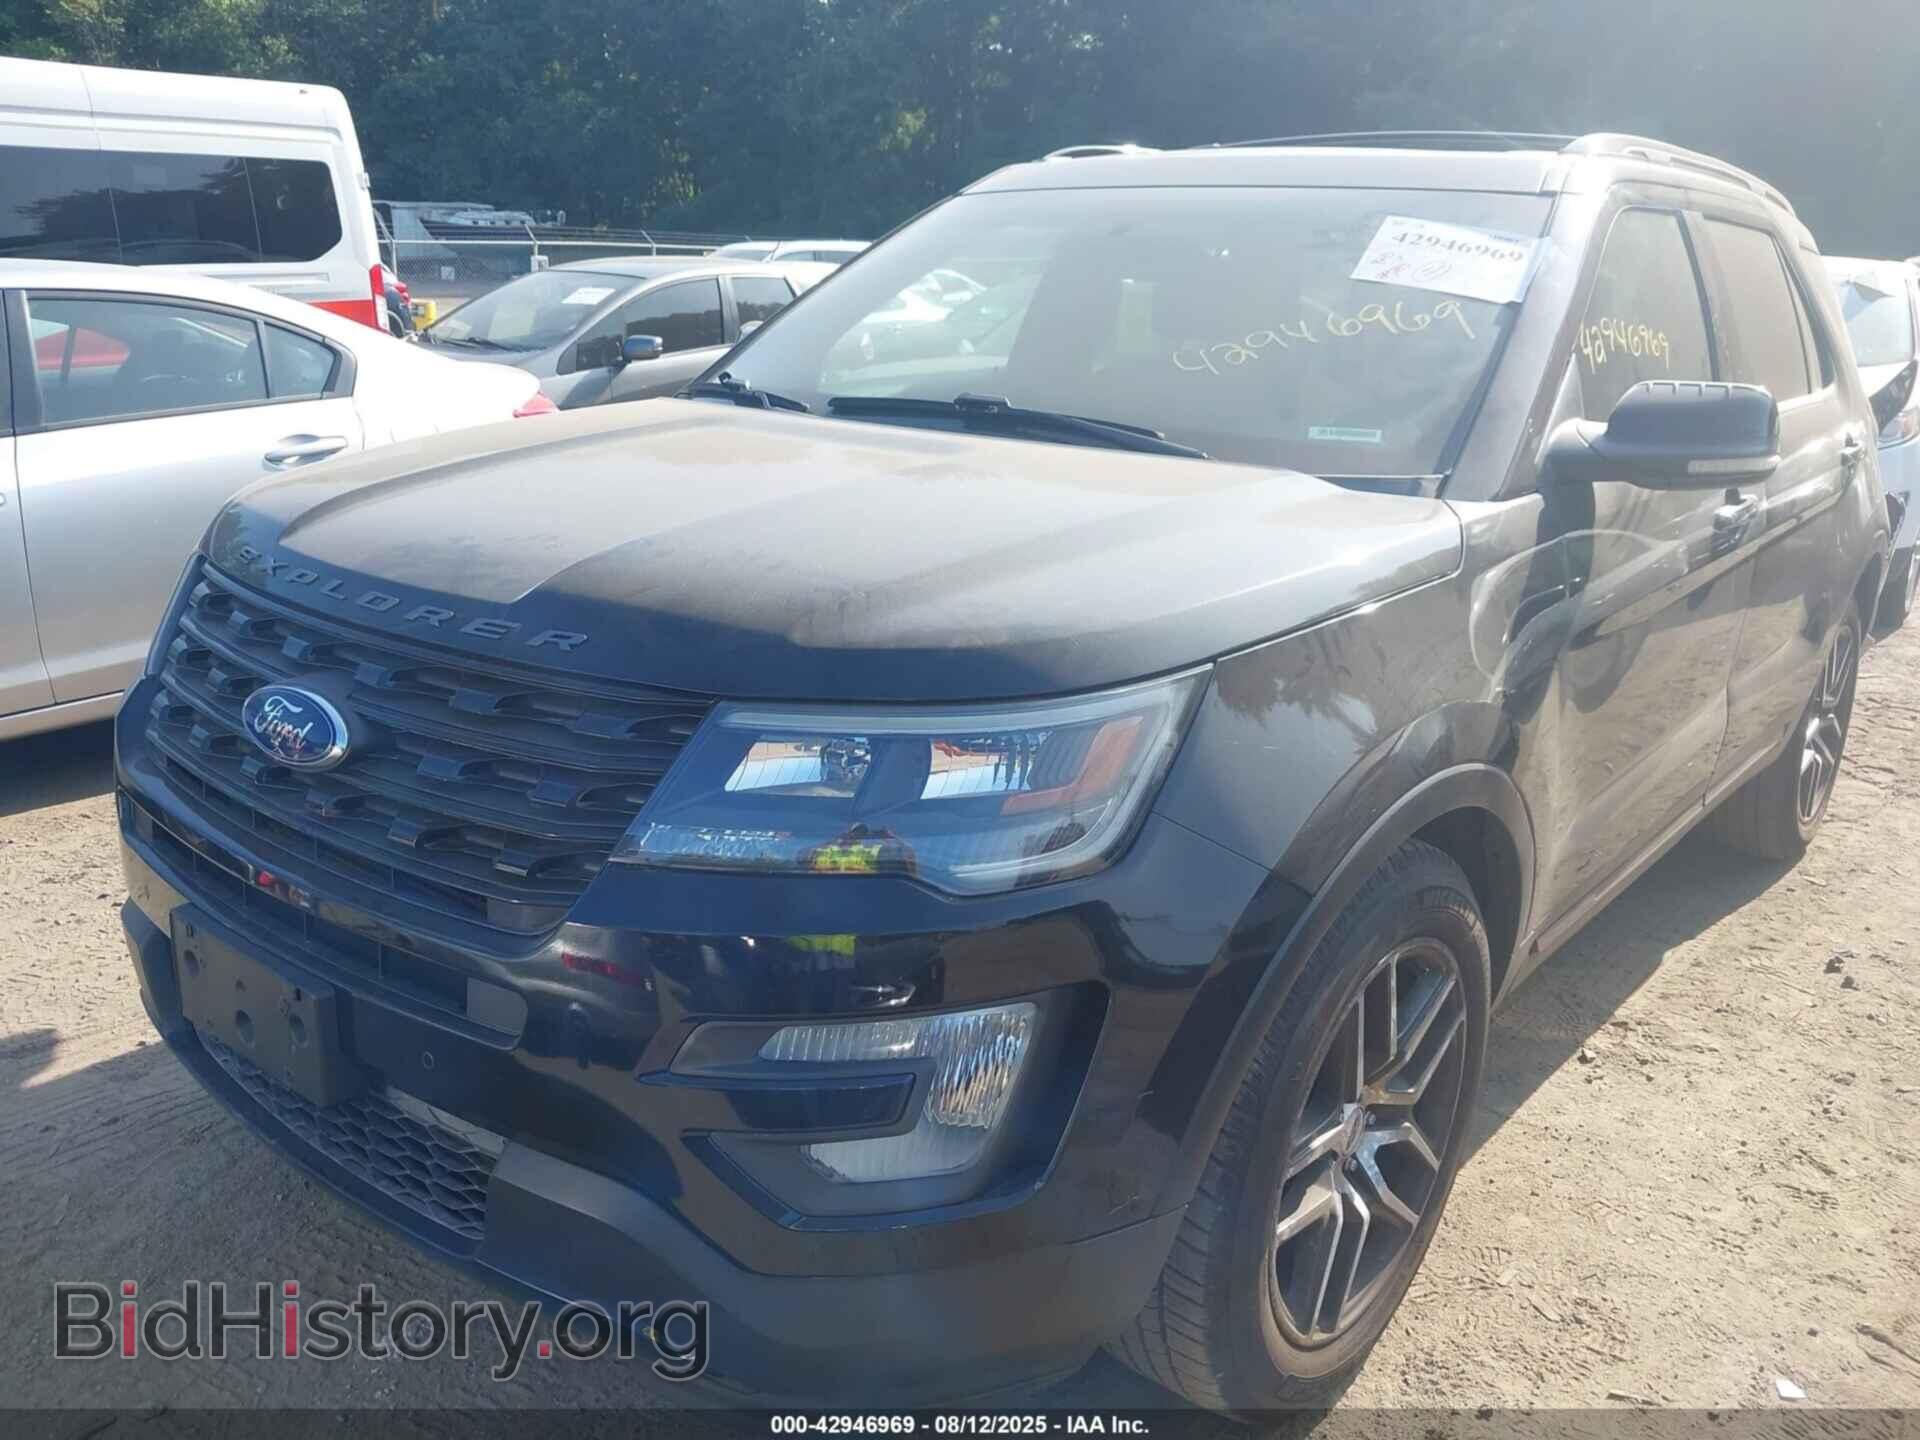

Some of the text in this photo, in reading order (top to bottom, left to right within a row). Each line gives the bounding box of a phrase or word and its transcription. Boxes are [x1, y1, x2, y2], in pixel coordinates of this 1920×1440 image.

[1391, 231, 1524, 263] 42946969
[1172, 299, 1475, 375] 42946969
[1579, 317, 1669, 374] 42946969
[238, 544, 591, 650] EXPLORER
[254, 695, 314, 750] Ford
